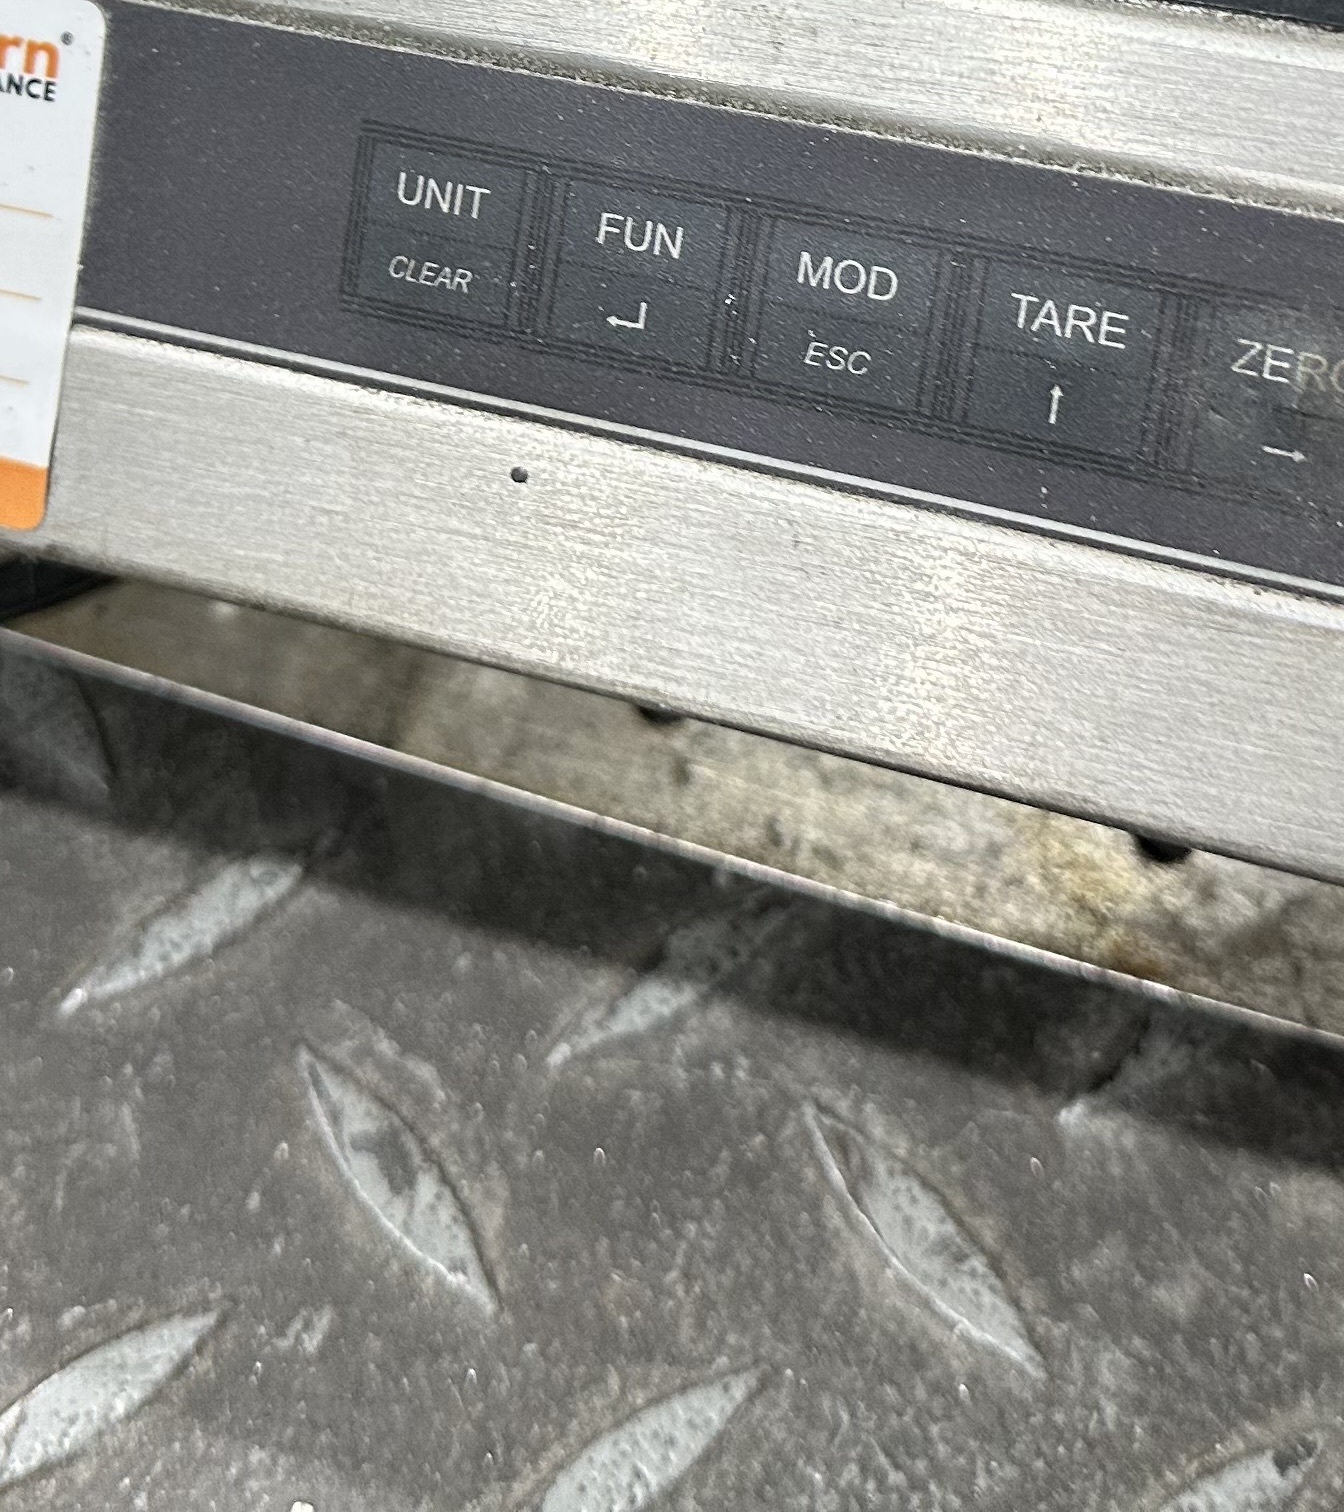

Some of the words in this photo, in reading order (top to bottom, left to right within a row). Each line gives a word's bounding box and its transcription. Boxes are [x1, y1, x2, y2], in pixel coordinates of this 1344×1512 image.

[397, 169, 490, 221] UNIT
[596, 210, 685, 259] FUN
[387, 254, 473, 293] CLEAR
[796, 249, 899, 303] MOD
[1010, 290, 1128, 351] TARE
[804, 336, 873, 377] ESC
